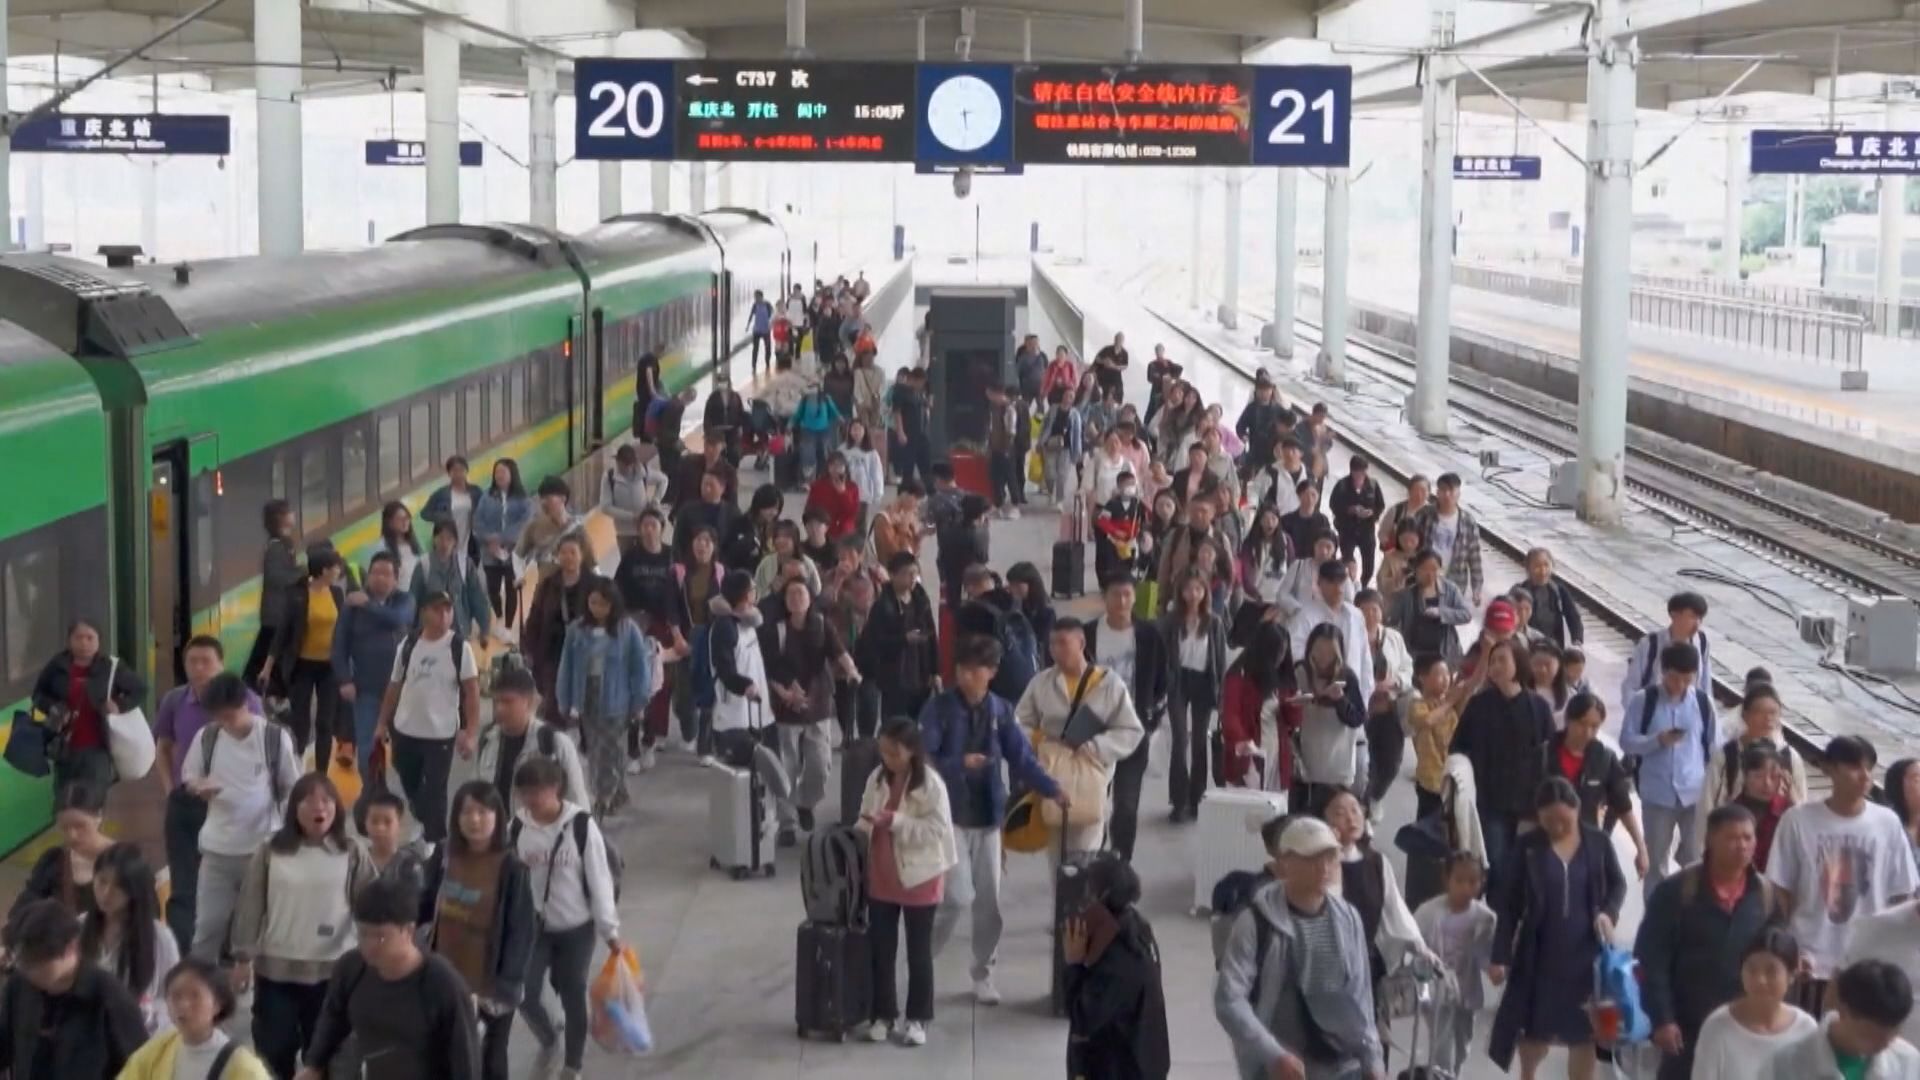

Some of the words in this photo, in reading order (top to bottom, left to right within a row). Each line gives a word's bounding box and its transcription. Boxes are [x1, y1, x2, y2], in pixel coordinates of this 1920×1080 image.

[791, 69, 809, 89] 次
[1034, 82, 1237, 103] 请在白色安全线内行走
[588, 82, 664, 138] 20
[688, 101, 735, 118] 重庆北
[747, 102, 779, 118] 开往
[1268, 89, 1334, 144] 21
